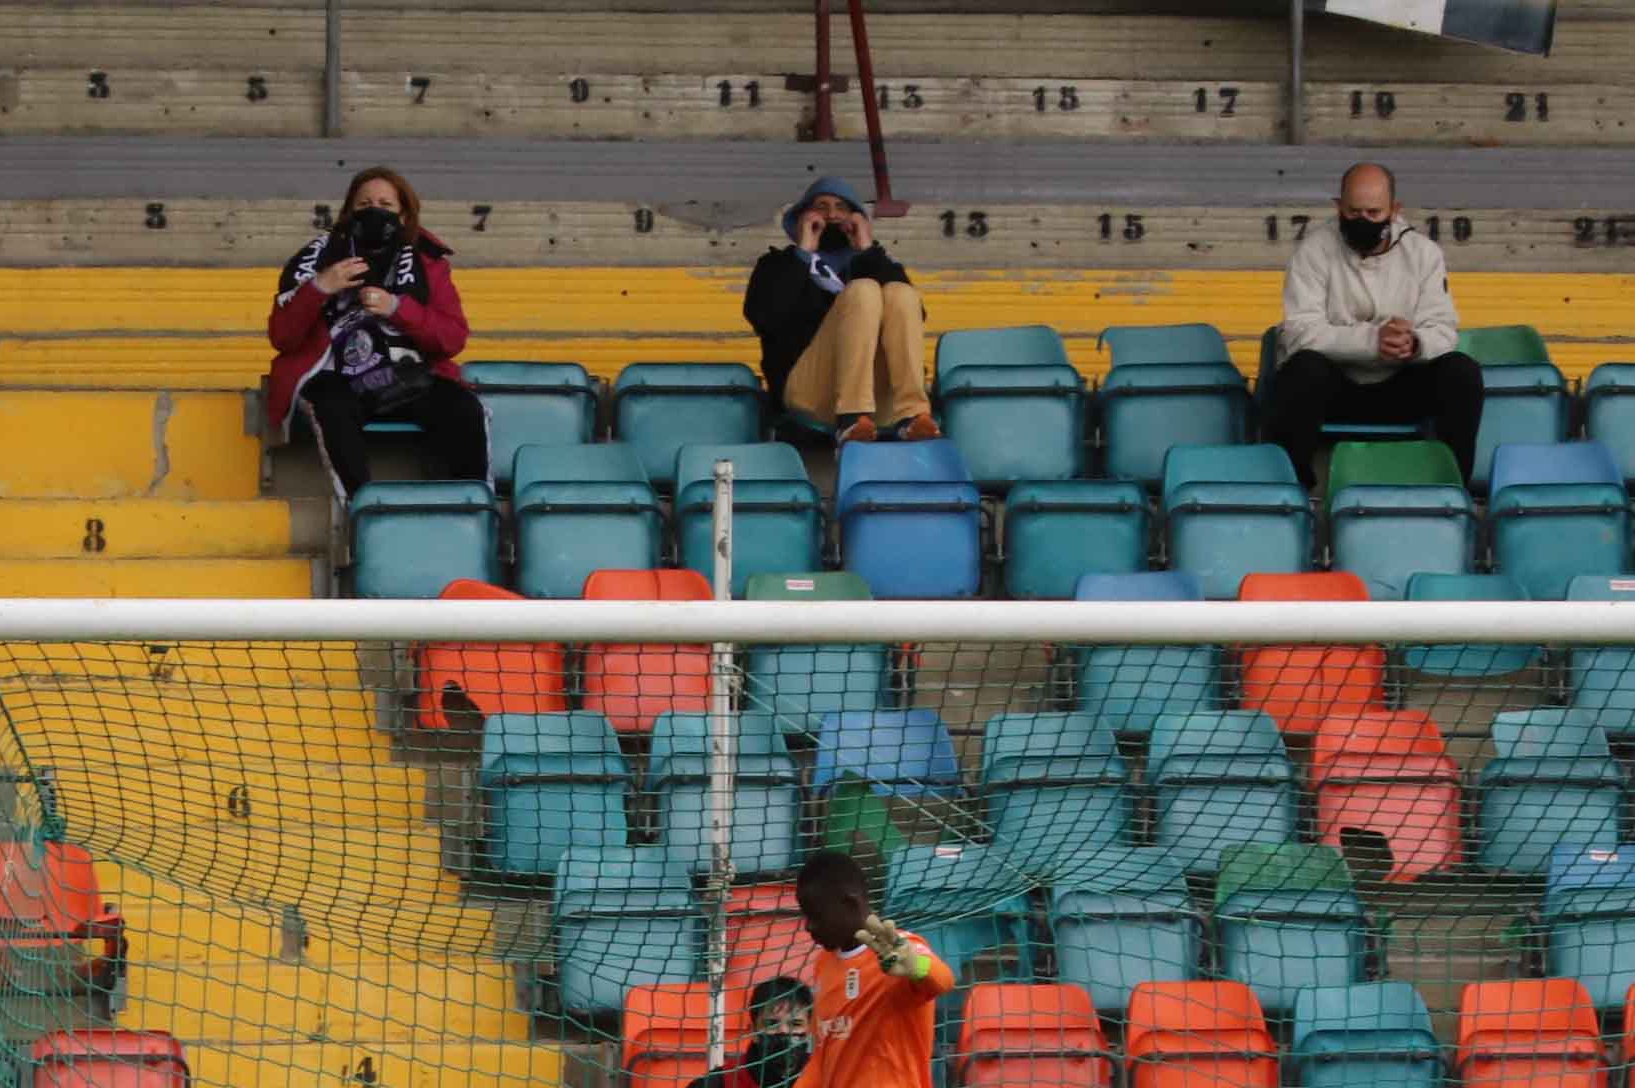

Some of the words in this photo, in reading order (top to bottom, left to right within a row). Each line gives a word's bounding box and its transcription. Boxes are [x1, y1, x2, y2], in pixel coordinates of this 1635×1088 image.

[410, 77, 432, 104] 7
[716, 80, 761, 108] 11
[877, 85, 924, 109] 13
[1032, 86, 1078, 112] 15
[1193, 87, 1240, 118] 17
[1505, 91, 1548, 121] 21
[470, 205, 493, 232] 7
[940, 210, 989, 239] 13
[1098, 213, 1145, 242] 15
[1264, 215, 1311, 243] 17
[82, 518, 106, 553] 8
[228, 785, 252, 819] 6
[353, 1056, 377, 1088] 4
